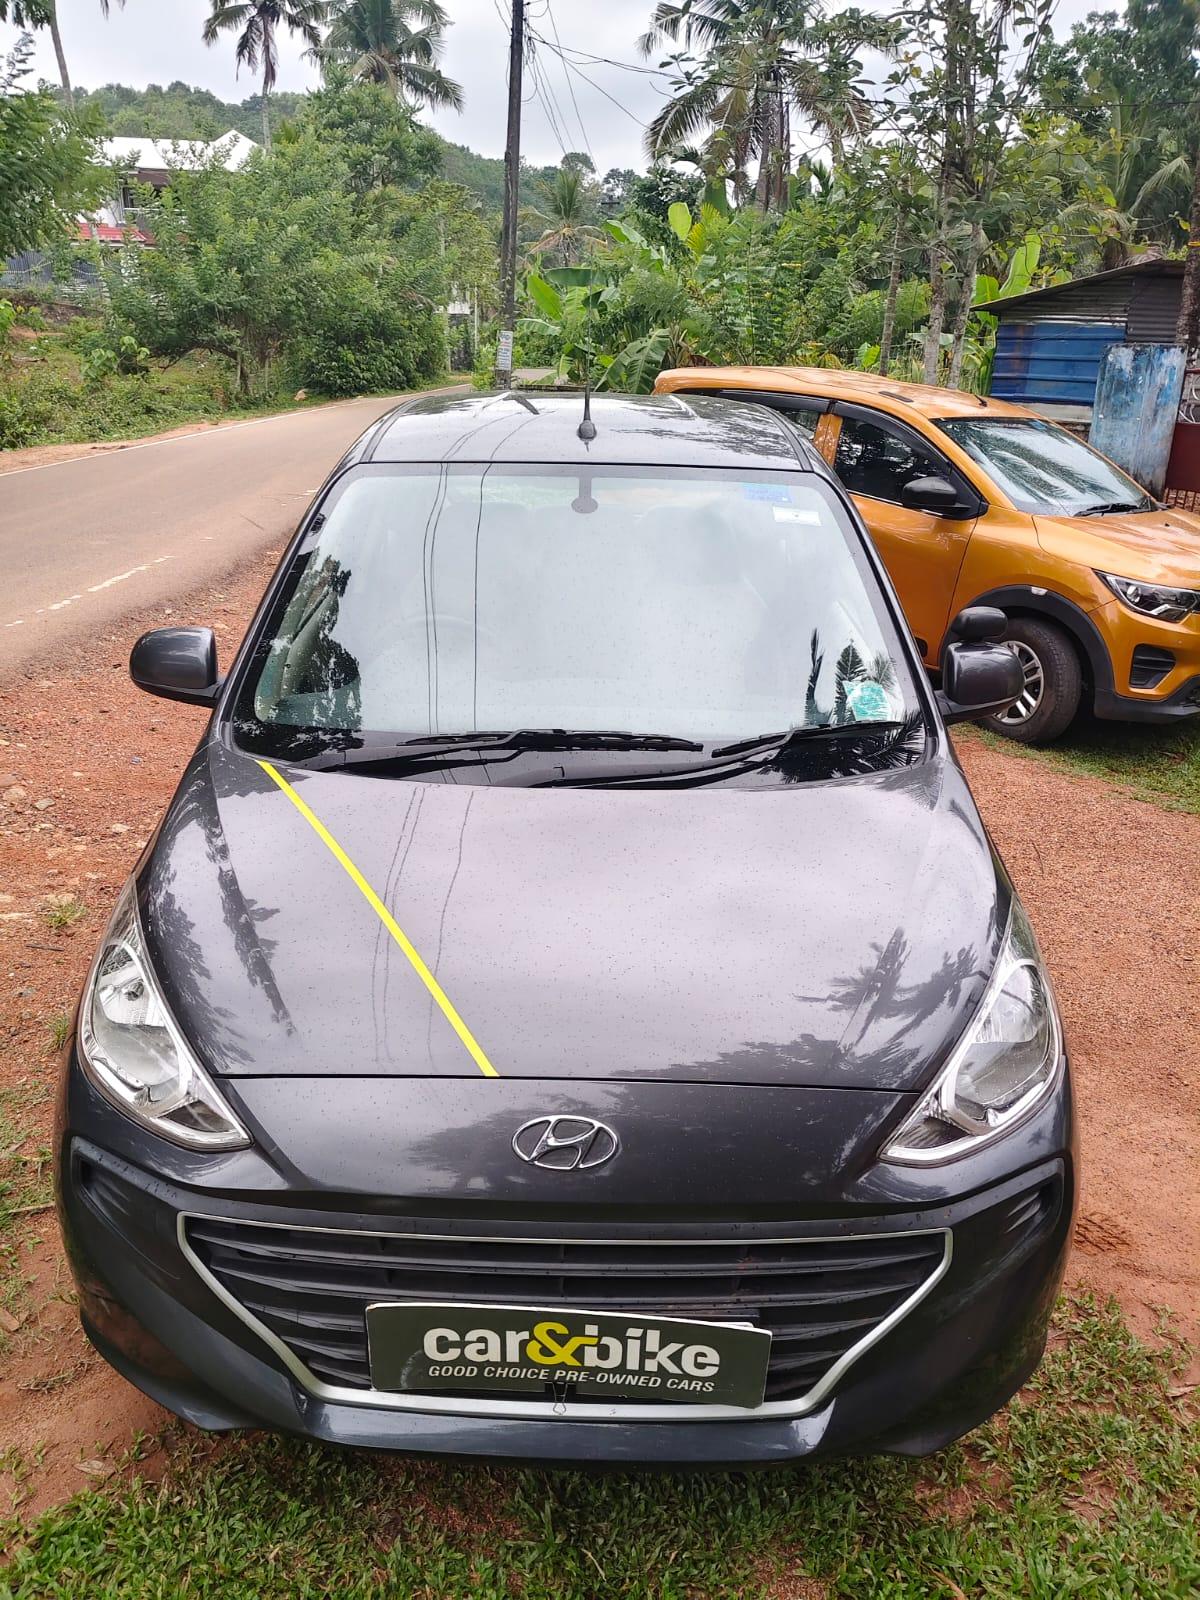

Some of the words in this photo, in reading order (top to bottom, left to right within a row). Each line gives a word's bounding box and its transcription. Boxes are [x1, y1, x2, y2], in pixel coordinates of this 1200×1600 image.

[428, 1365, 478, 1378] GOOD
[483, 1367, 549, 1380] CHOICE
[554, 1369, 662, 1389] PRE-OWNED
[666, 1378, 715, 1393] CARS
